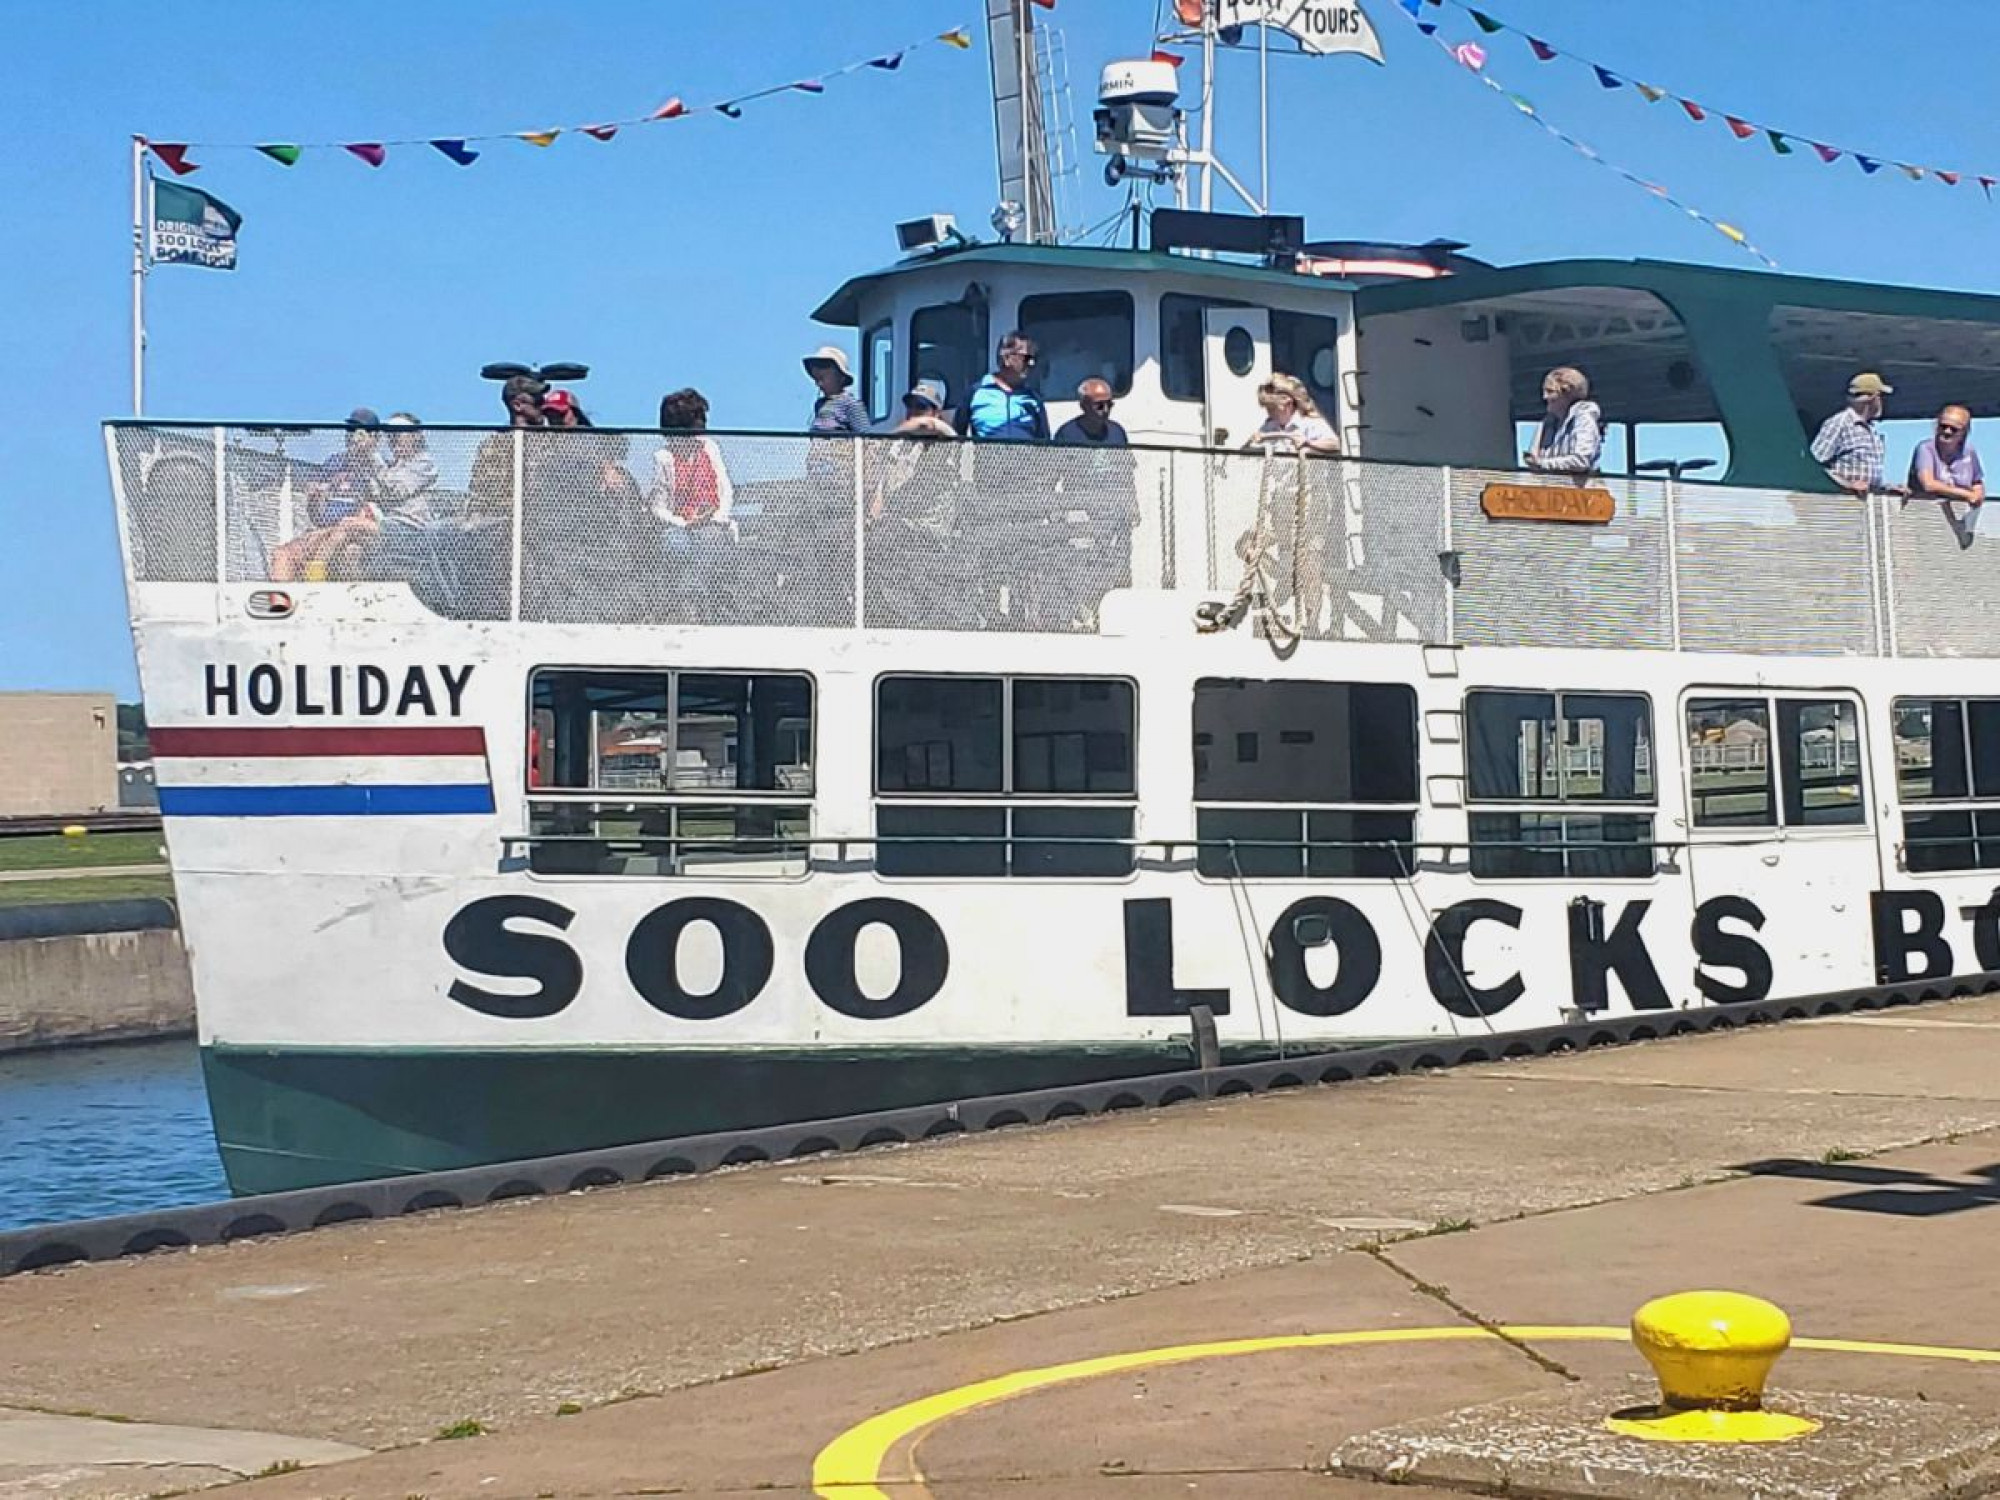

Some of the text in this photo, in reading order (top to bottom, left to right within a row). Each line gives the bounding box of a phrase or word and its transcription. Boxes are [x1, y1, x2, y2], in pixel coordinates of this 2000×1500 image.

[1303, 8, 1359, 34] TOURS
[1502, 489, 1595, 514] HOLIDAY
[205, 664, 474, 716] HOLIDAY
[443, 894, 949, 1020] SOO
[1124, 894, 1774, 1018] LOCKS
